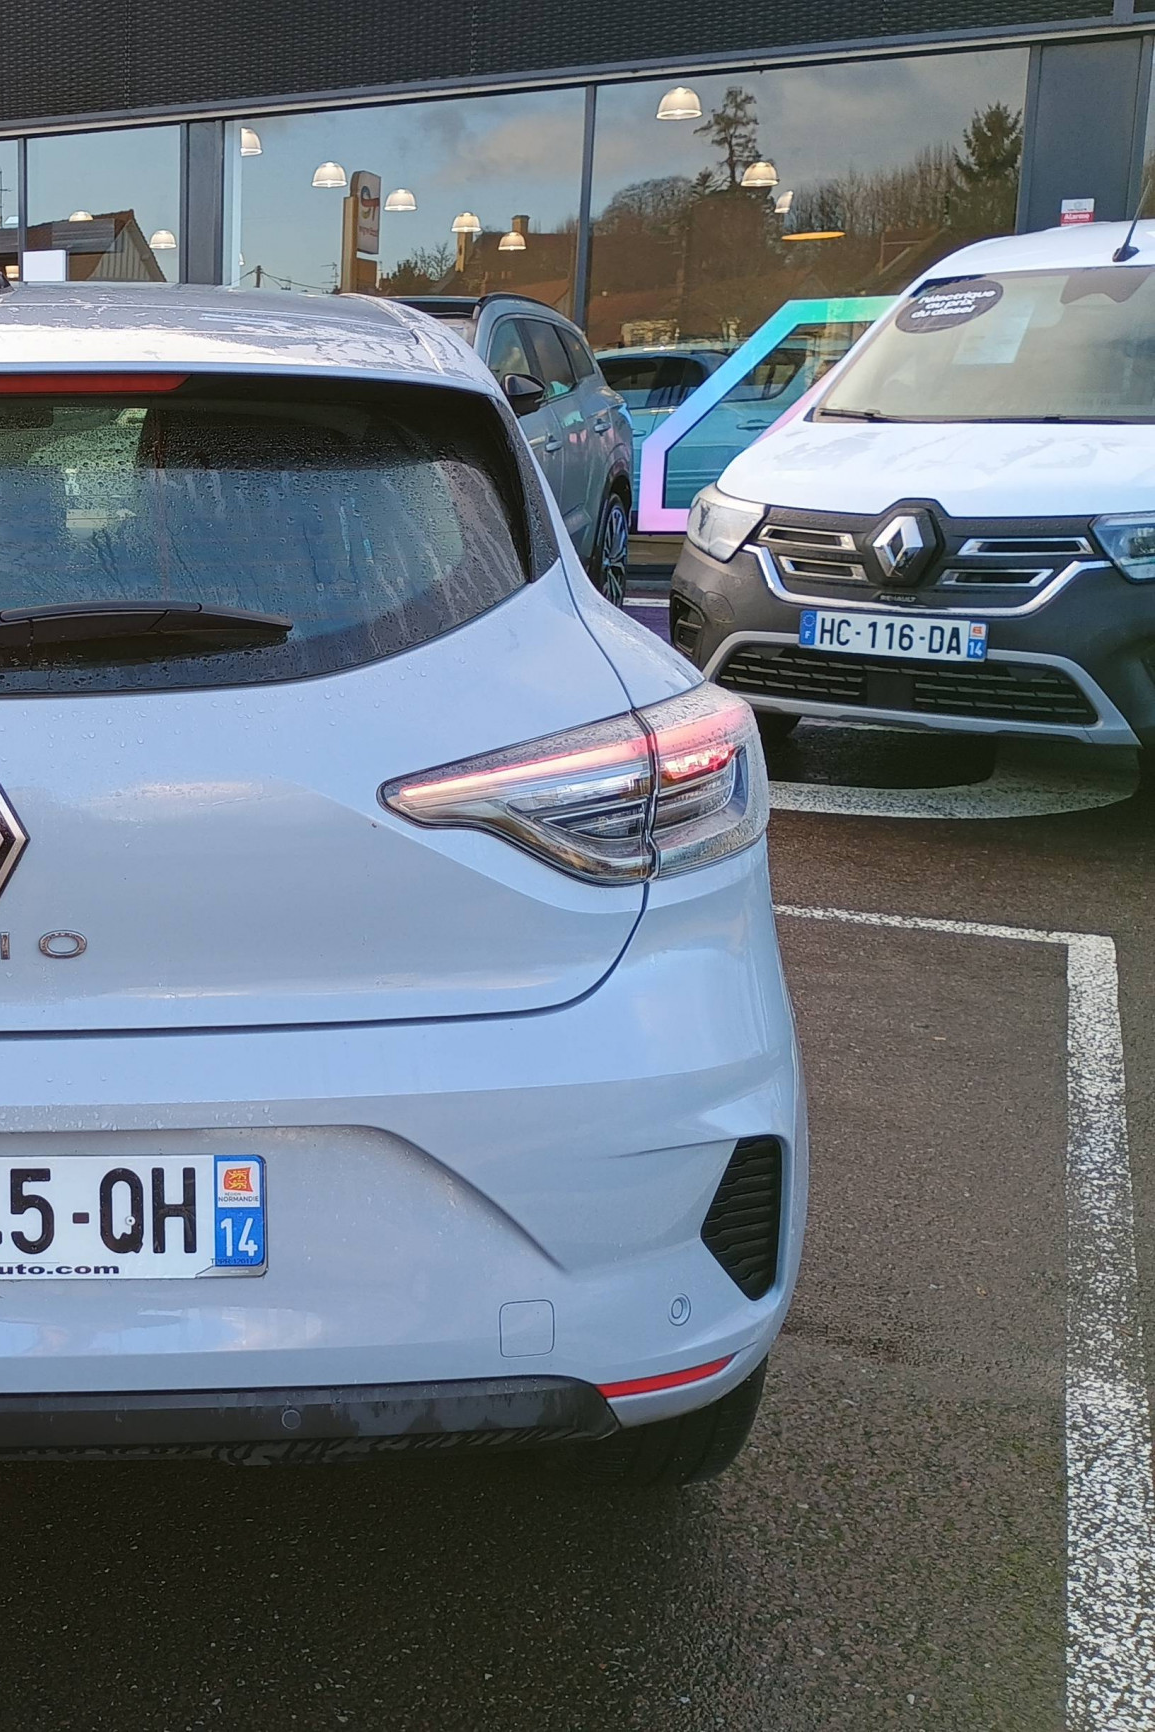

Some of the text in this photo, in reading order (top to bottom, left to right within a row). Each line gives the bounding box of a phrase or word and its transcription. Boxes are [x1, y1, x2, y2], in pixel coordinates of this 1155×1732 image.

[926, 299, 974, 309] au prix
[911, 305, 977, 318] du diesel
[805, 631, 811, 640] F
[819, 618, 961, 655] HC-116-DA
[969, 641, 983, 657] 14
[221, 1217, 258, 1256] 14
